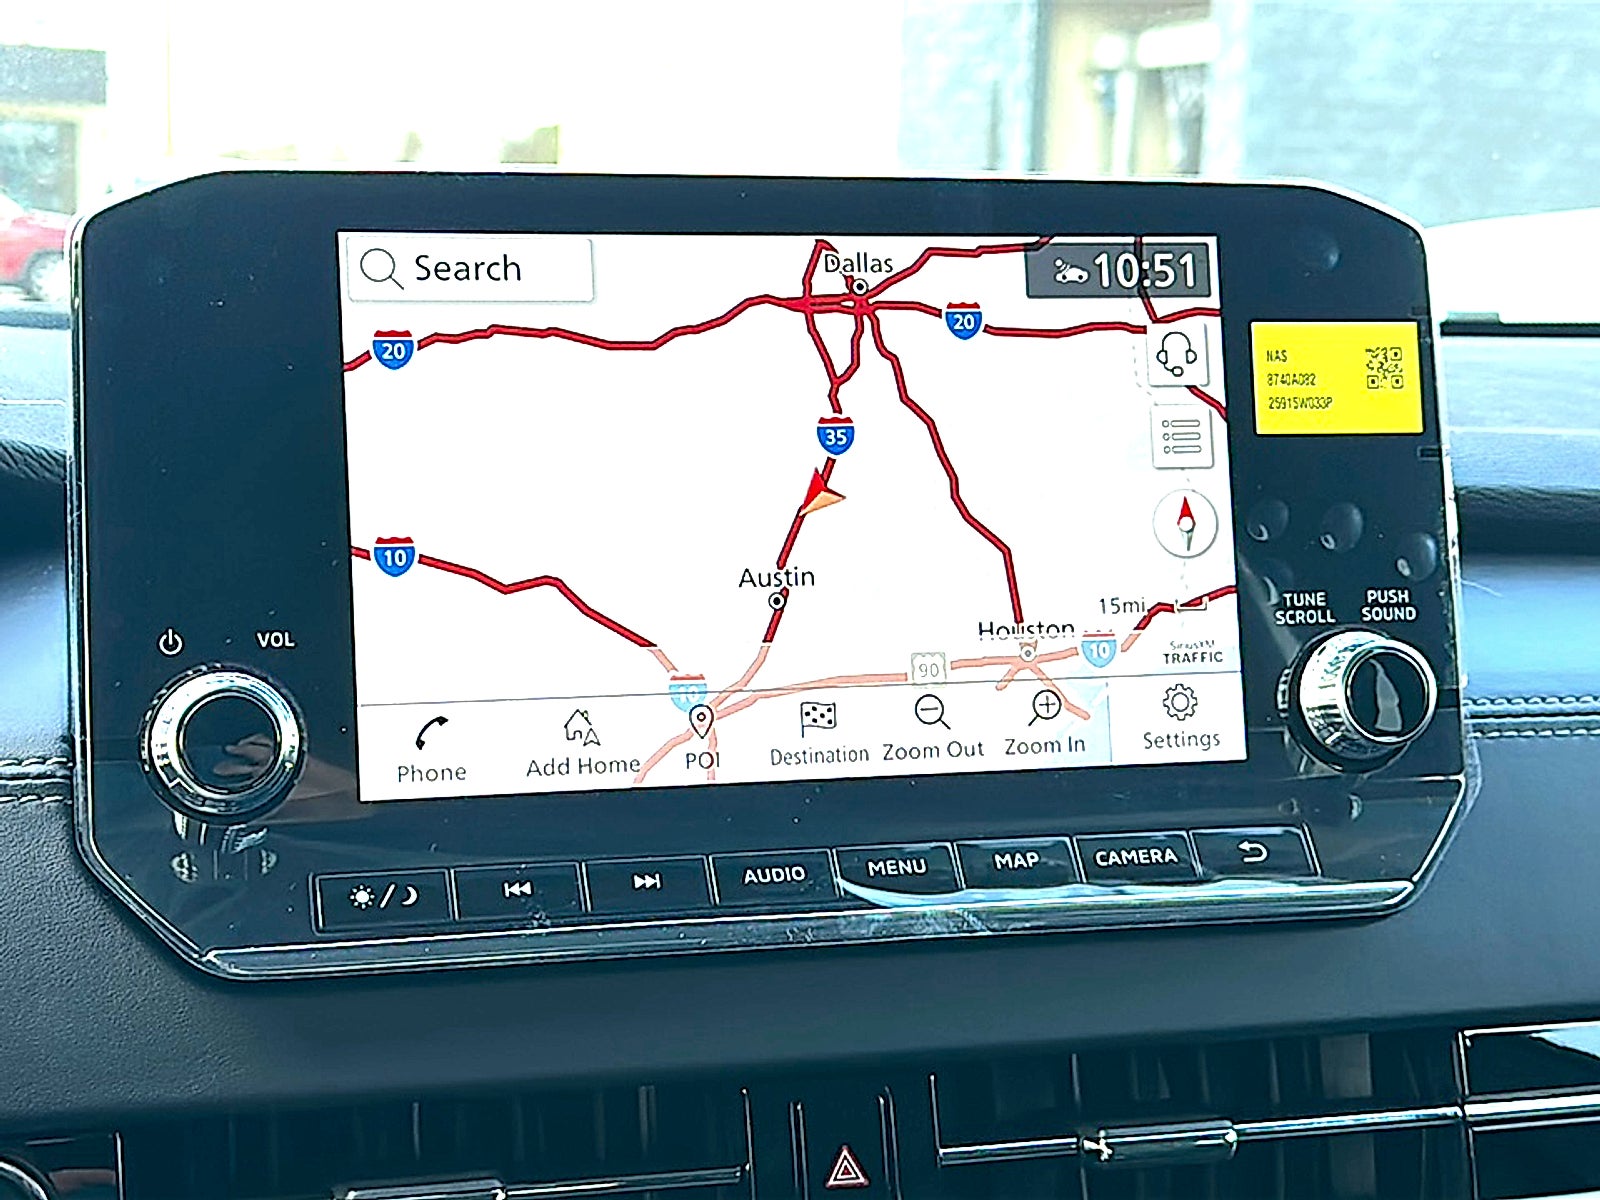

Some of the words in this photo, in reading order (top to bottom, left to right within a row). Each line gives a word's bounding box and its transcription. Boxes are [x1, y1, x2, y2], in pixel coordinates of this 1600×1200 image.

[416, 254, 522, 282] Search
[824, 252, 894, 273] Dallas
[1094, 252, 1195, 288] 10:51
[953, 314, 975, 330] 20
[382, 343, 405, 360] 20
[1267, 349, 1287, 362] NAS
[826, 429, 848, 445] 35
[384, 550, 407, 566] 10
[739, 567, 815, 588] Austin
[1099, 597, 1146, 614] 15mi
[1282, 592, 1327, 607] TUNE
[1366, 590, 1409, 604] PUSH
[1274, 610, 1336, 625] SCROLL
[1362, 606, 1417, 622] SOUND
[256, 631, 296, 648] VOL
[978, 621, 1075, 641] Houston
[1089, 642, 1110, 659] 10
[1163, 651, 1224, 665] TRAFFIC
[918, 662, 939, 678] 90
[1005, 738, 1062, 756] Zoom
[1069, 736, 1086, 753] In
[1143, 730, 1220, 752] Settings
[685, 748, 720, 770] POI
[770, 745, 870, 766] Destination
[883, 744, 940, 761] Zoom
[946, 740, 985, 758] Out
[398, 765, 466, 782] Phone
[526, 757, 570, 777] Add
[578, 756, 641, 775] Home
[994, 851, 1040, 870] MAP
[1096, 848, 1179, 867] CAMERA
[745, 866, 806, 884] AUDIO
[867, 857, 927, 877] MENU
